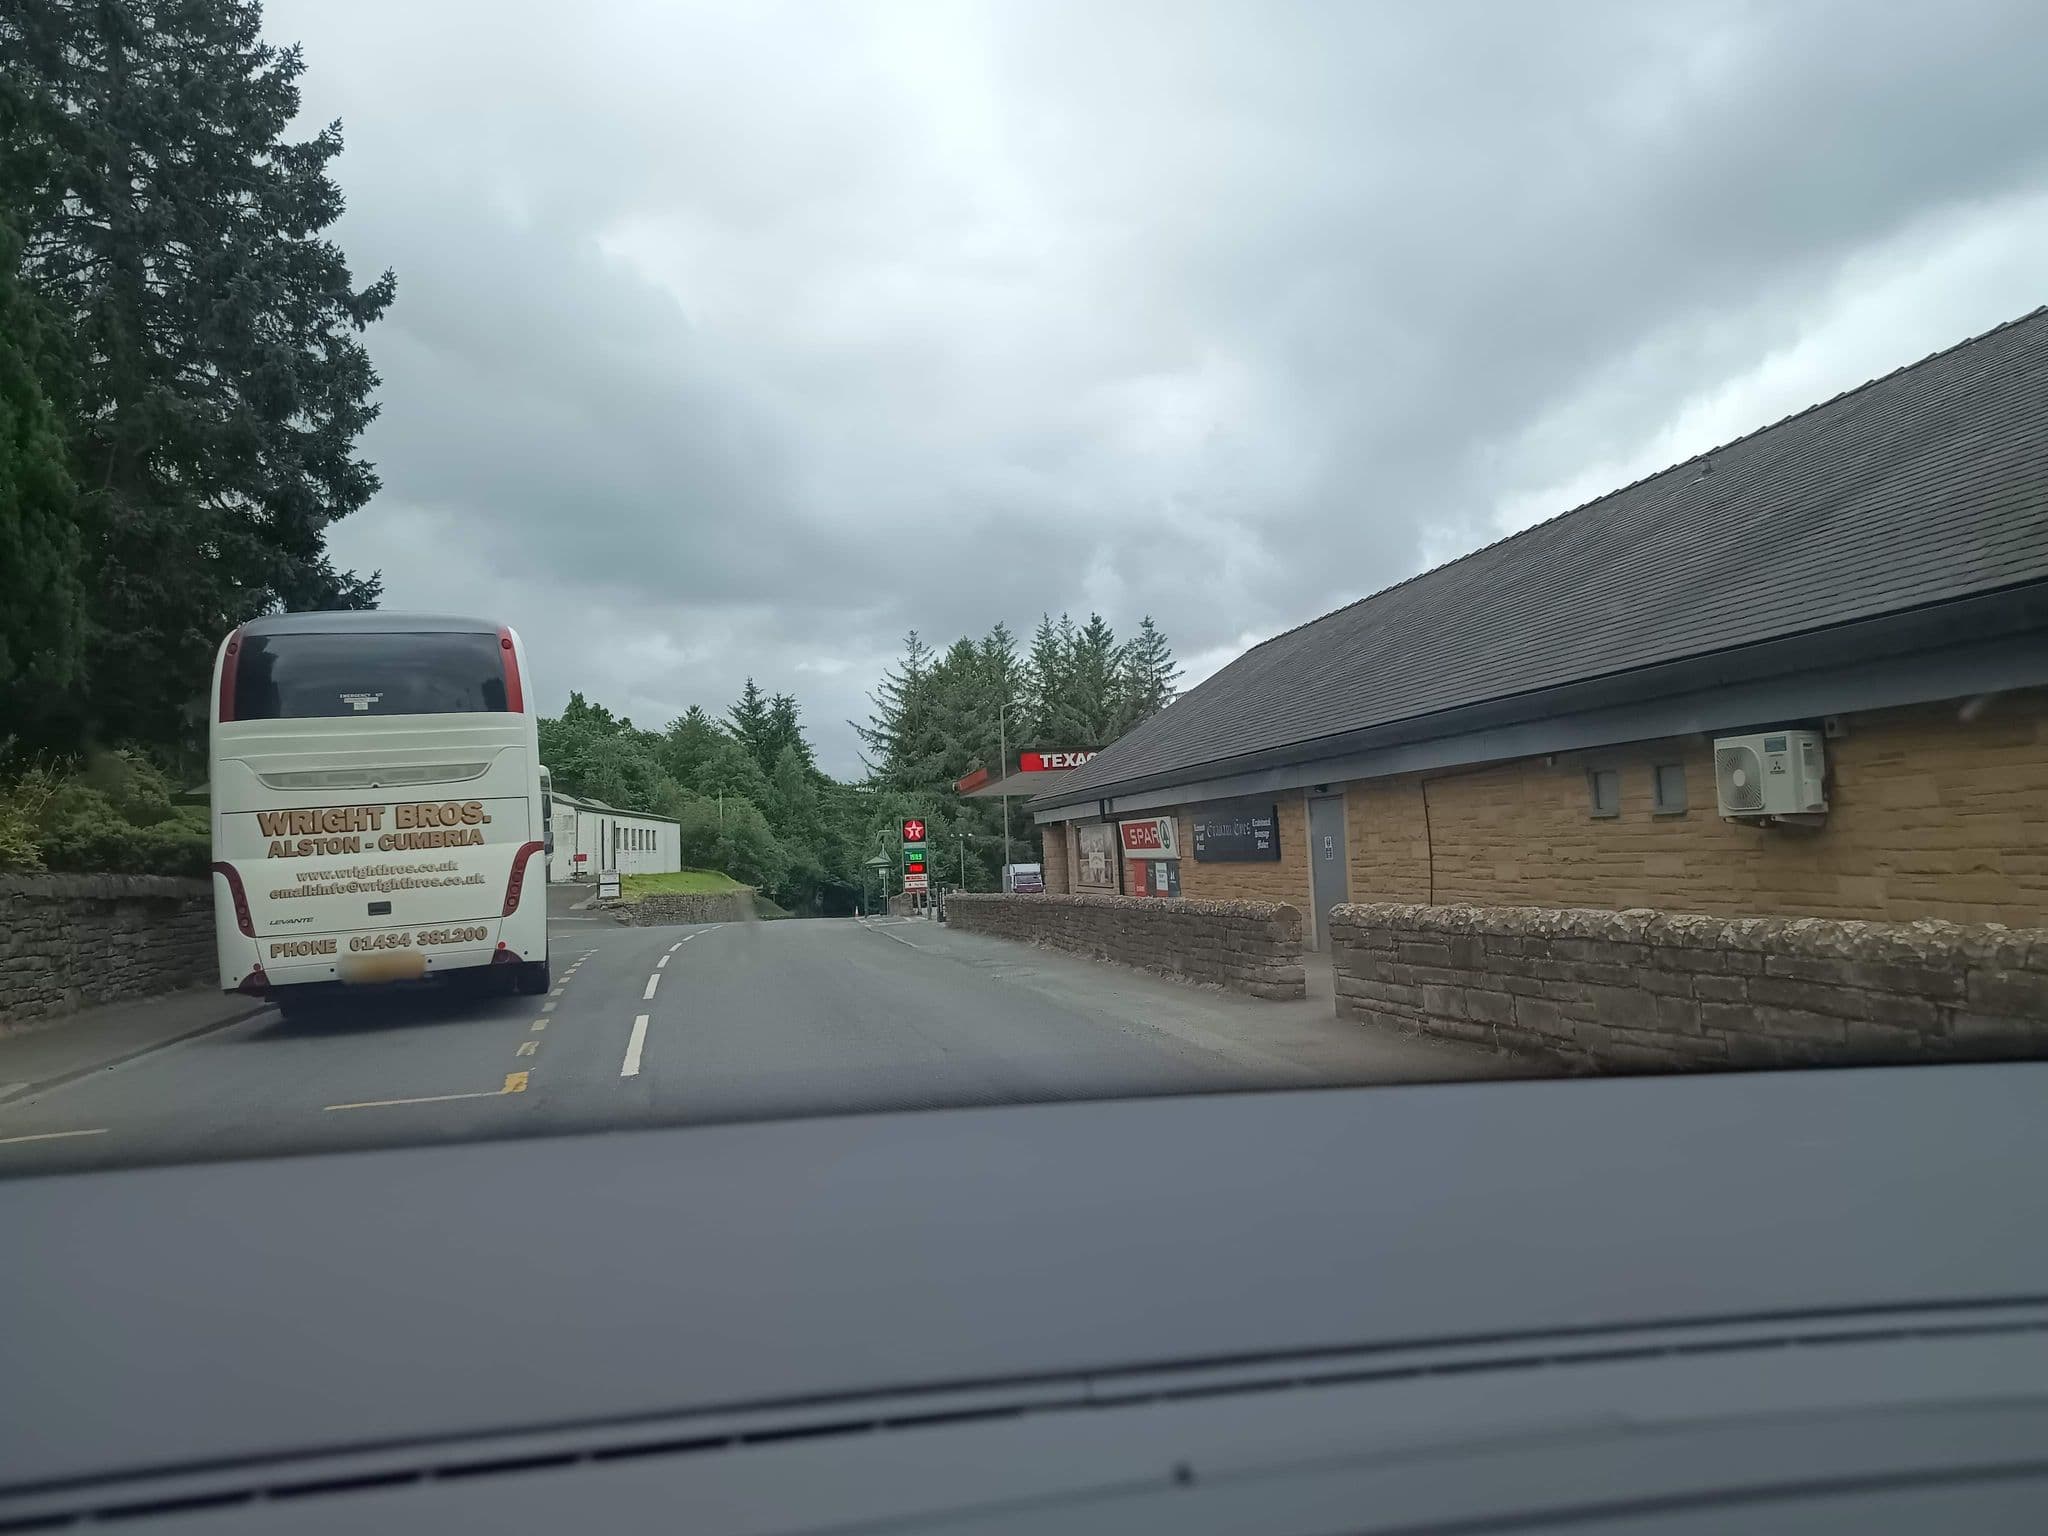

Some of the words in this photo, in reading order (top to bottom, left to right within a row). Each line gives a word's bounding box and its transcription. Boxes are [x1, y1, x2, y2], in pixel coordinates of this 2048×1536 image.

[257, 806, 385, 837] WRIGHT
[396, 801, 492, 829] BROS.
[267, 836, 361, 858] ALSTON
[378, 829, 485, 851] CUMBRIA
[1129, 825, 1160, 845] SPAR
[296, 861, 459, 882] www.wrightbros.co.uk
[269, 917, 314, 925] LEVANTE
[270, 939, 337, 958] PHONE
[350, 932, 411, 951] 01434
[417, 926, 488, 946] 381200
